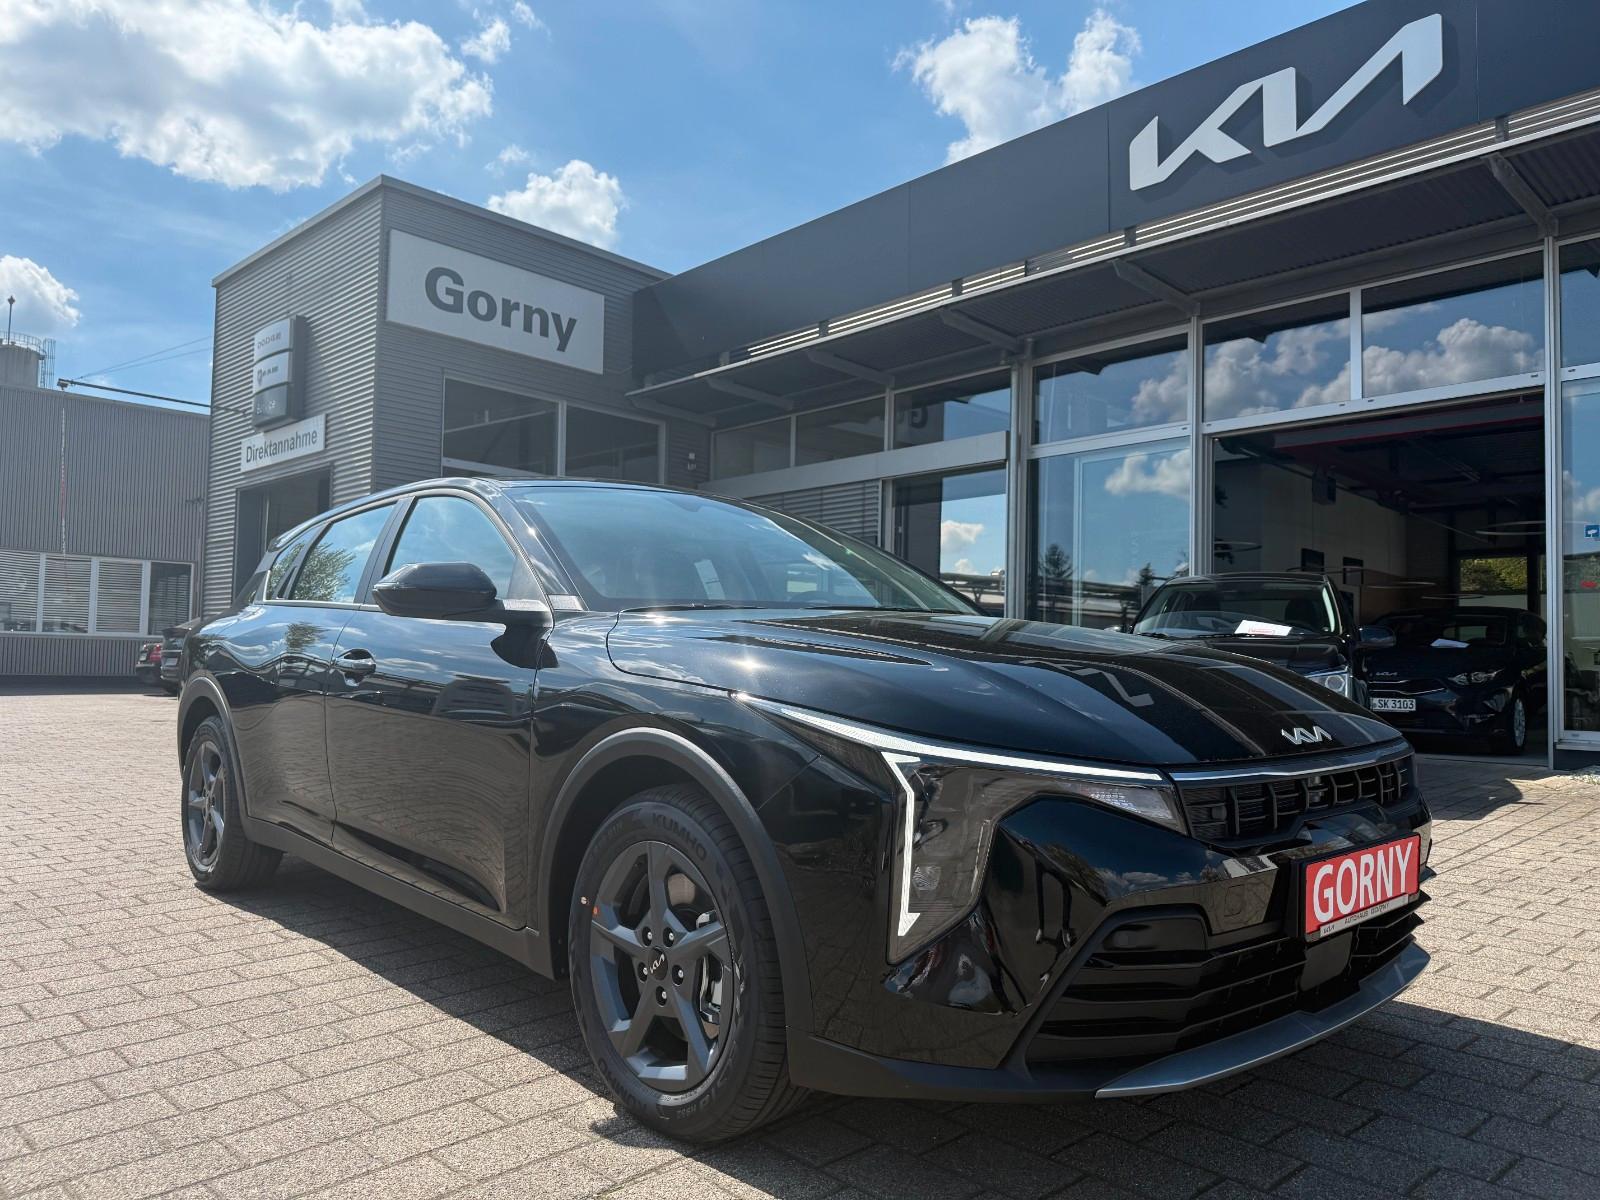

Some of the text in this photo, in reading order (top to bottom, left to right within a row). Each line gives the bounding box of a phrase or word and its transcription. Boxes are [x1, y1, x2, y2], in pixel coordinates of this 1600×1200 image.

[1129, 13, 1443, 191] KIA
[425, 266, 578, 353] Gorny
[246, 430, 318, 463] Direktannahme
[1377, 699, 1414, 710] SK 3103
[1281, 725, 1333, 745] KIA
[652, 812, 707, 861] KUMHO
[1313, 842, 1413, 923] GORNY
